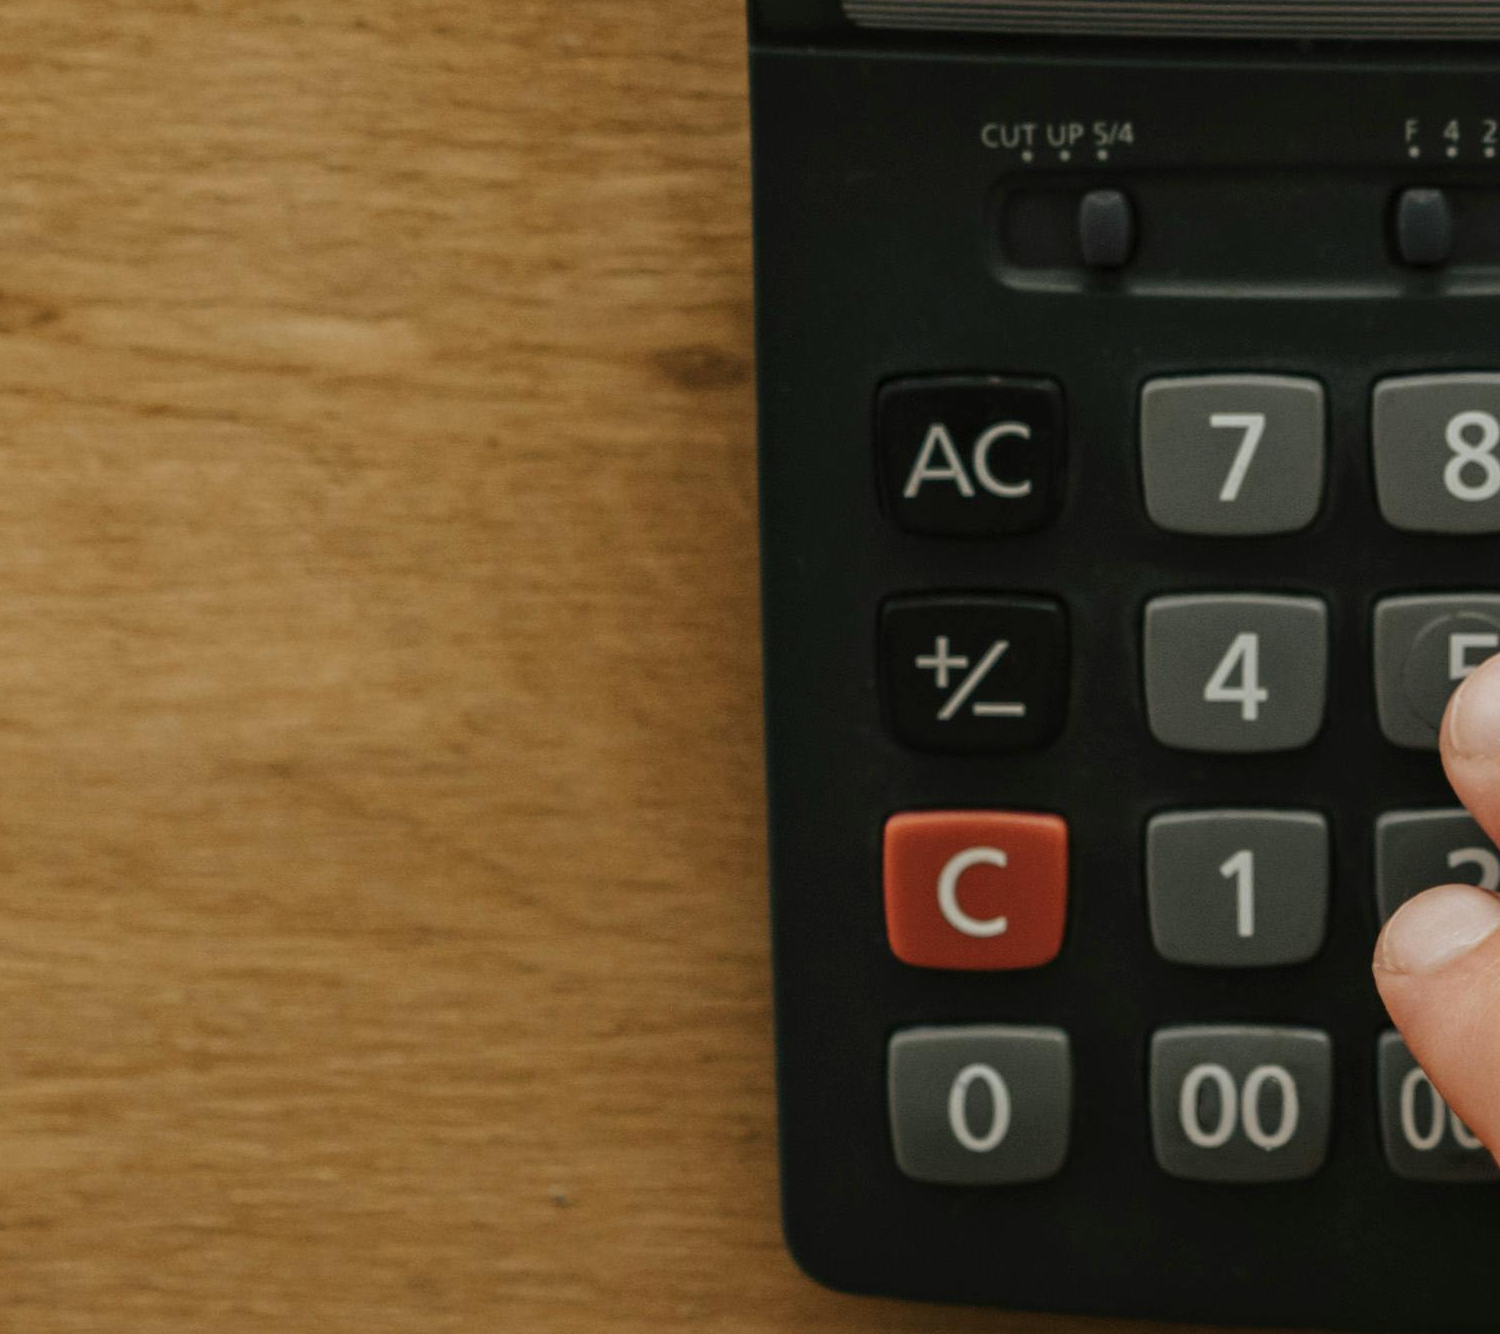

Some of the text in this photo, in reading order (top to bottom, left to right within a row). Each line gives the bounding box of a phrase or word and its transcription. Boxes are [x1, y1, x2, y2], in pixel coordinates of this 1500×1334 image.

[980, 121, 1135, 149] CUT UP 5/4
[1404, 118, 1418, 142] F
[1443, 119, 1460, 142] 4
[1482, 119, 1498, 144] 2
[903, 422, 1031, 498] AC
[1209, 413, 1266, 501] 7
[1203, 632, 1268, 721] 4
[937, 847, 1008, 937] C
[1219, 849, 1254, 937] 1
[1180, 1063, 1299, 1151] 00
